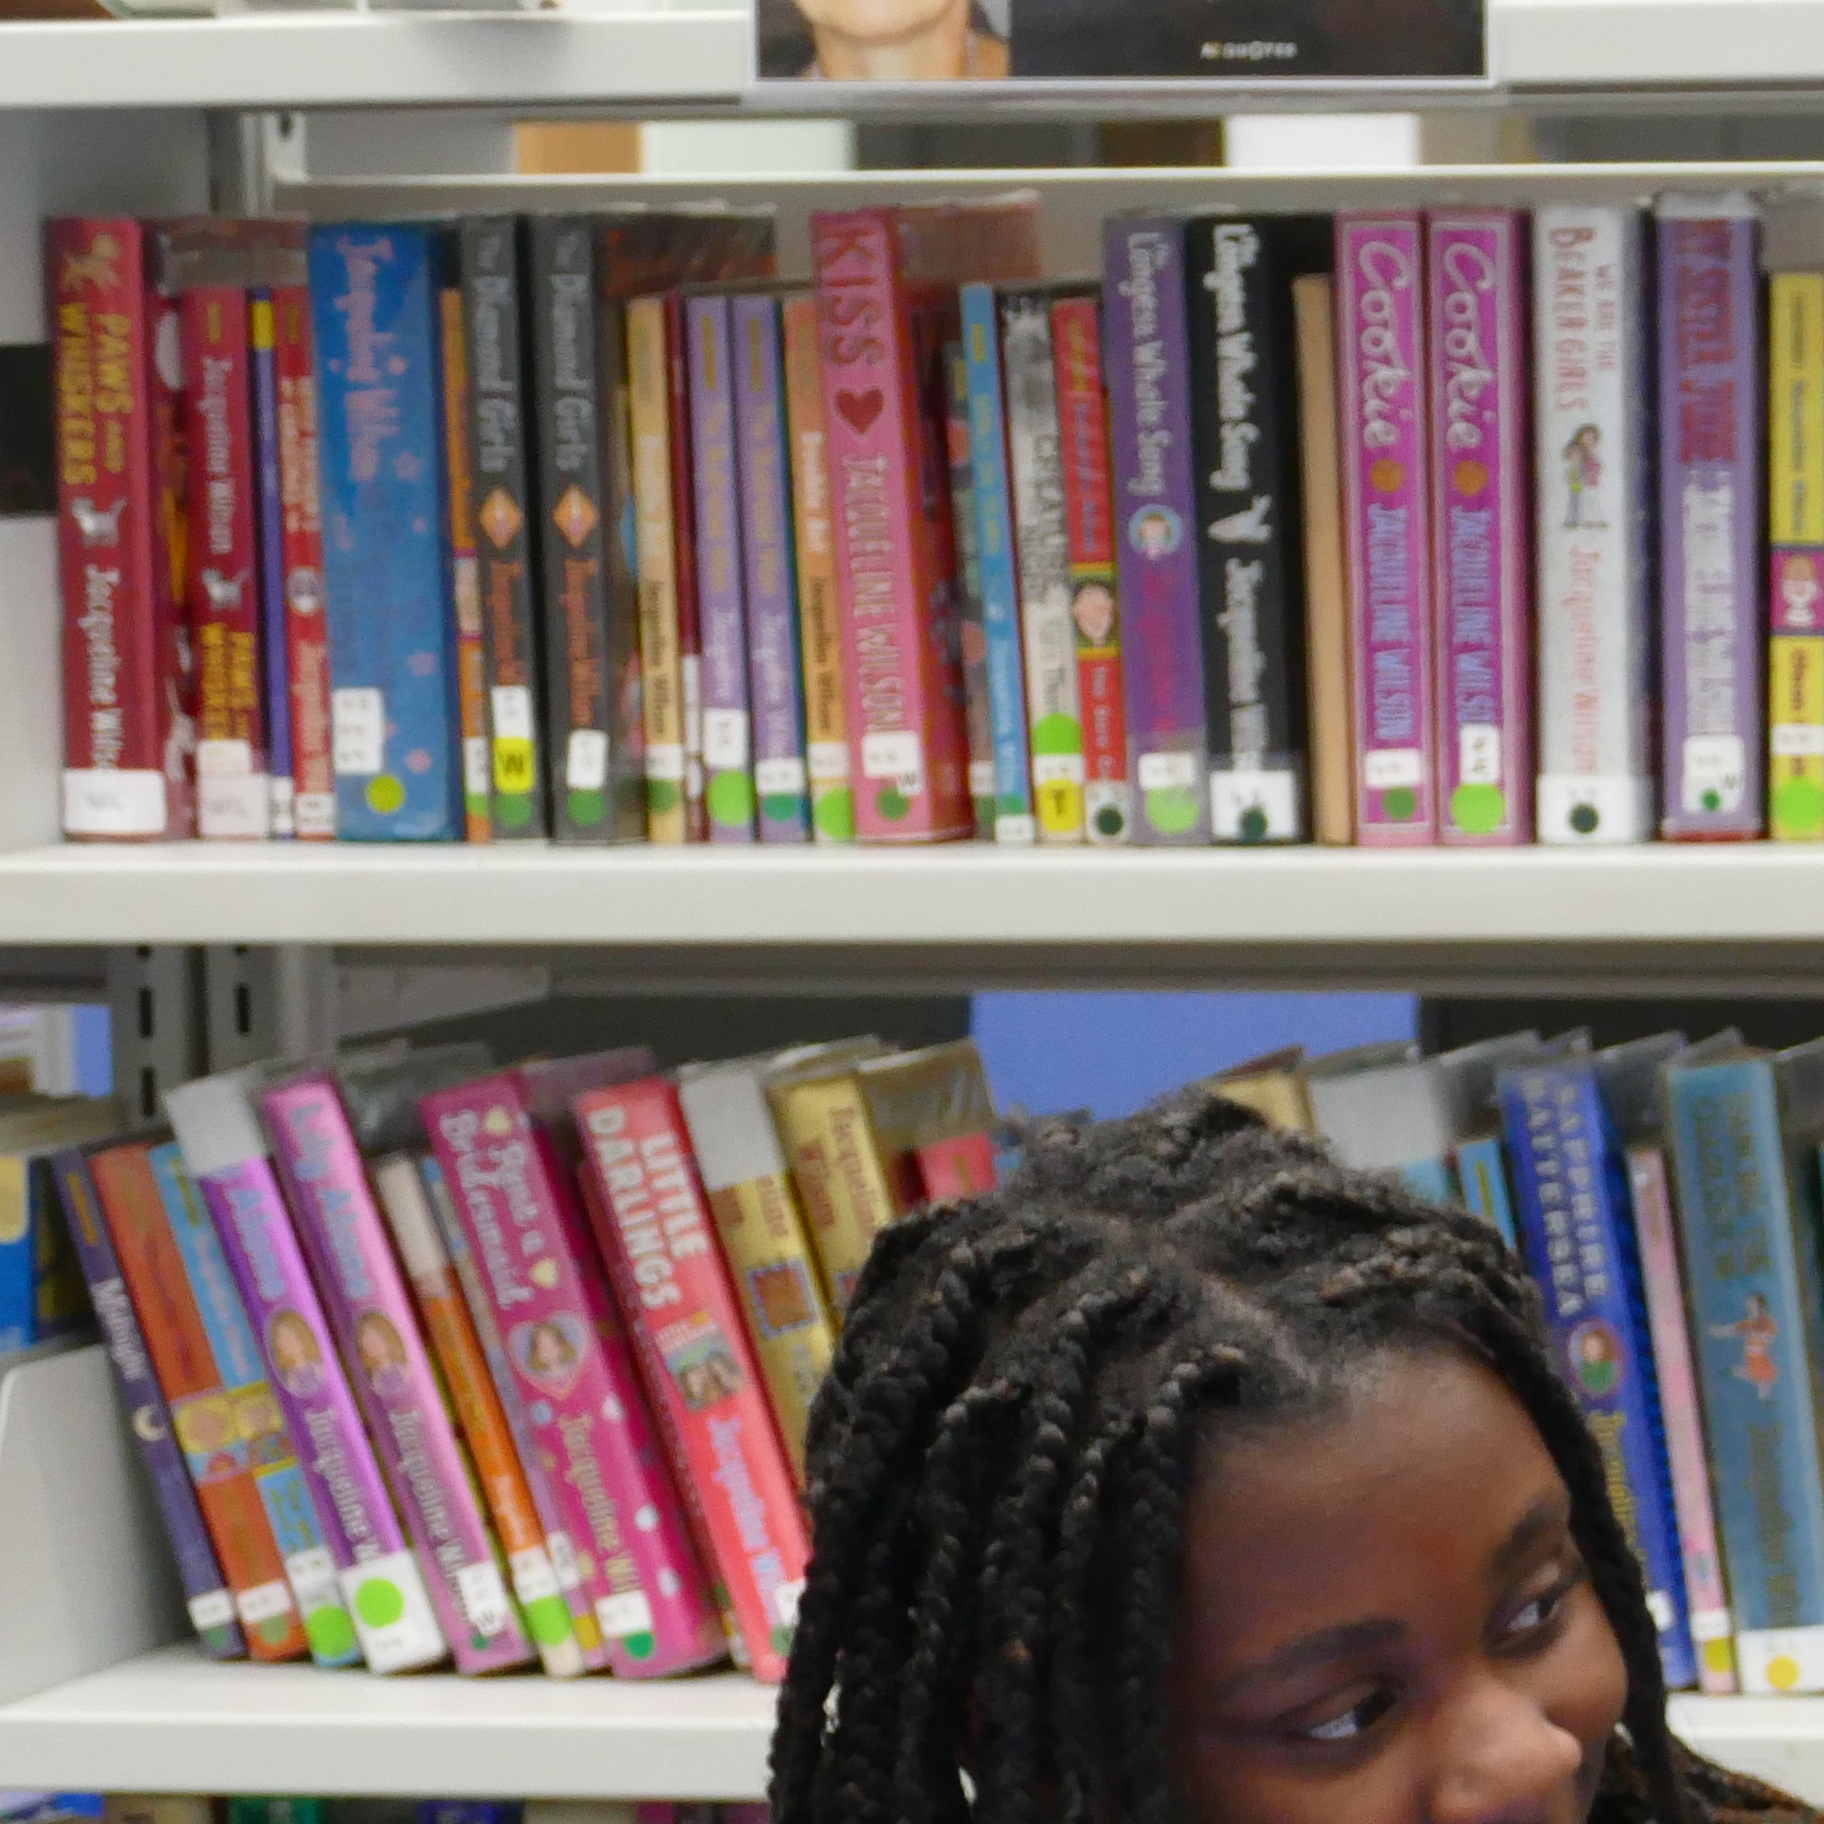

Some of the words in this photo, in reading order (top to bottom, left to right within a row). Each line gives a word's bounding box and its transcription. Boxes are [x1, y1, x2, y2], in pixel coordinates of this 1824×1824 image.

[1358, 243, 1415, 450] Cookie
[1443, 243, 1500, 450] Cookie
[587, 1105, 670, 1312] DARLINGS
[640, 1131, 710, 1260] LITTLE
